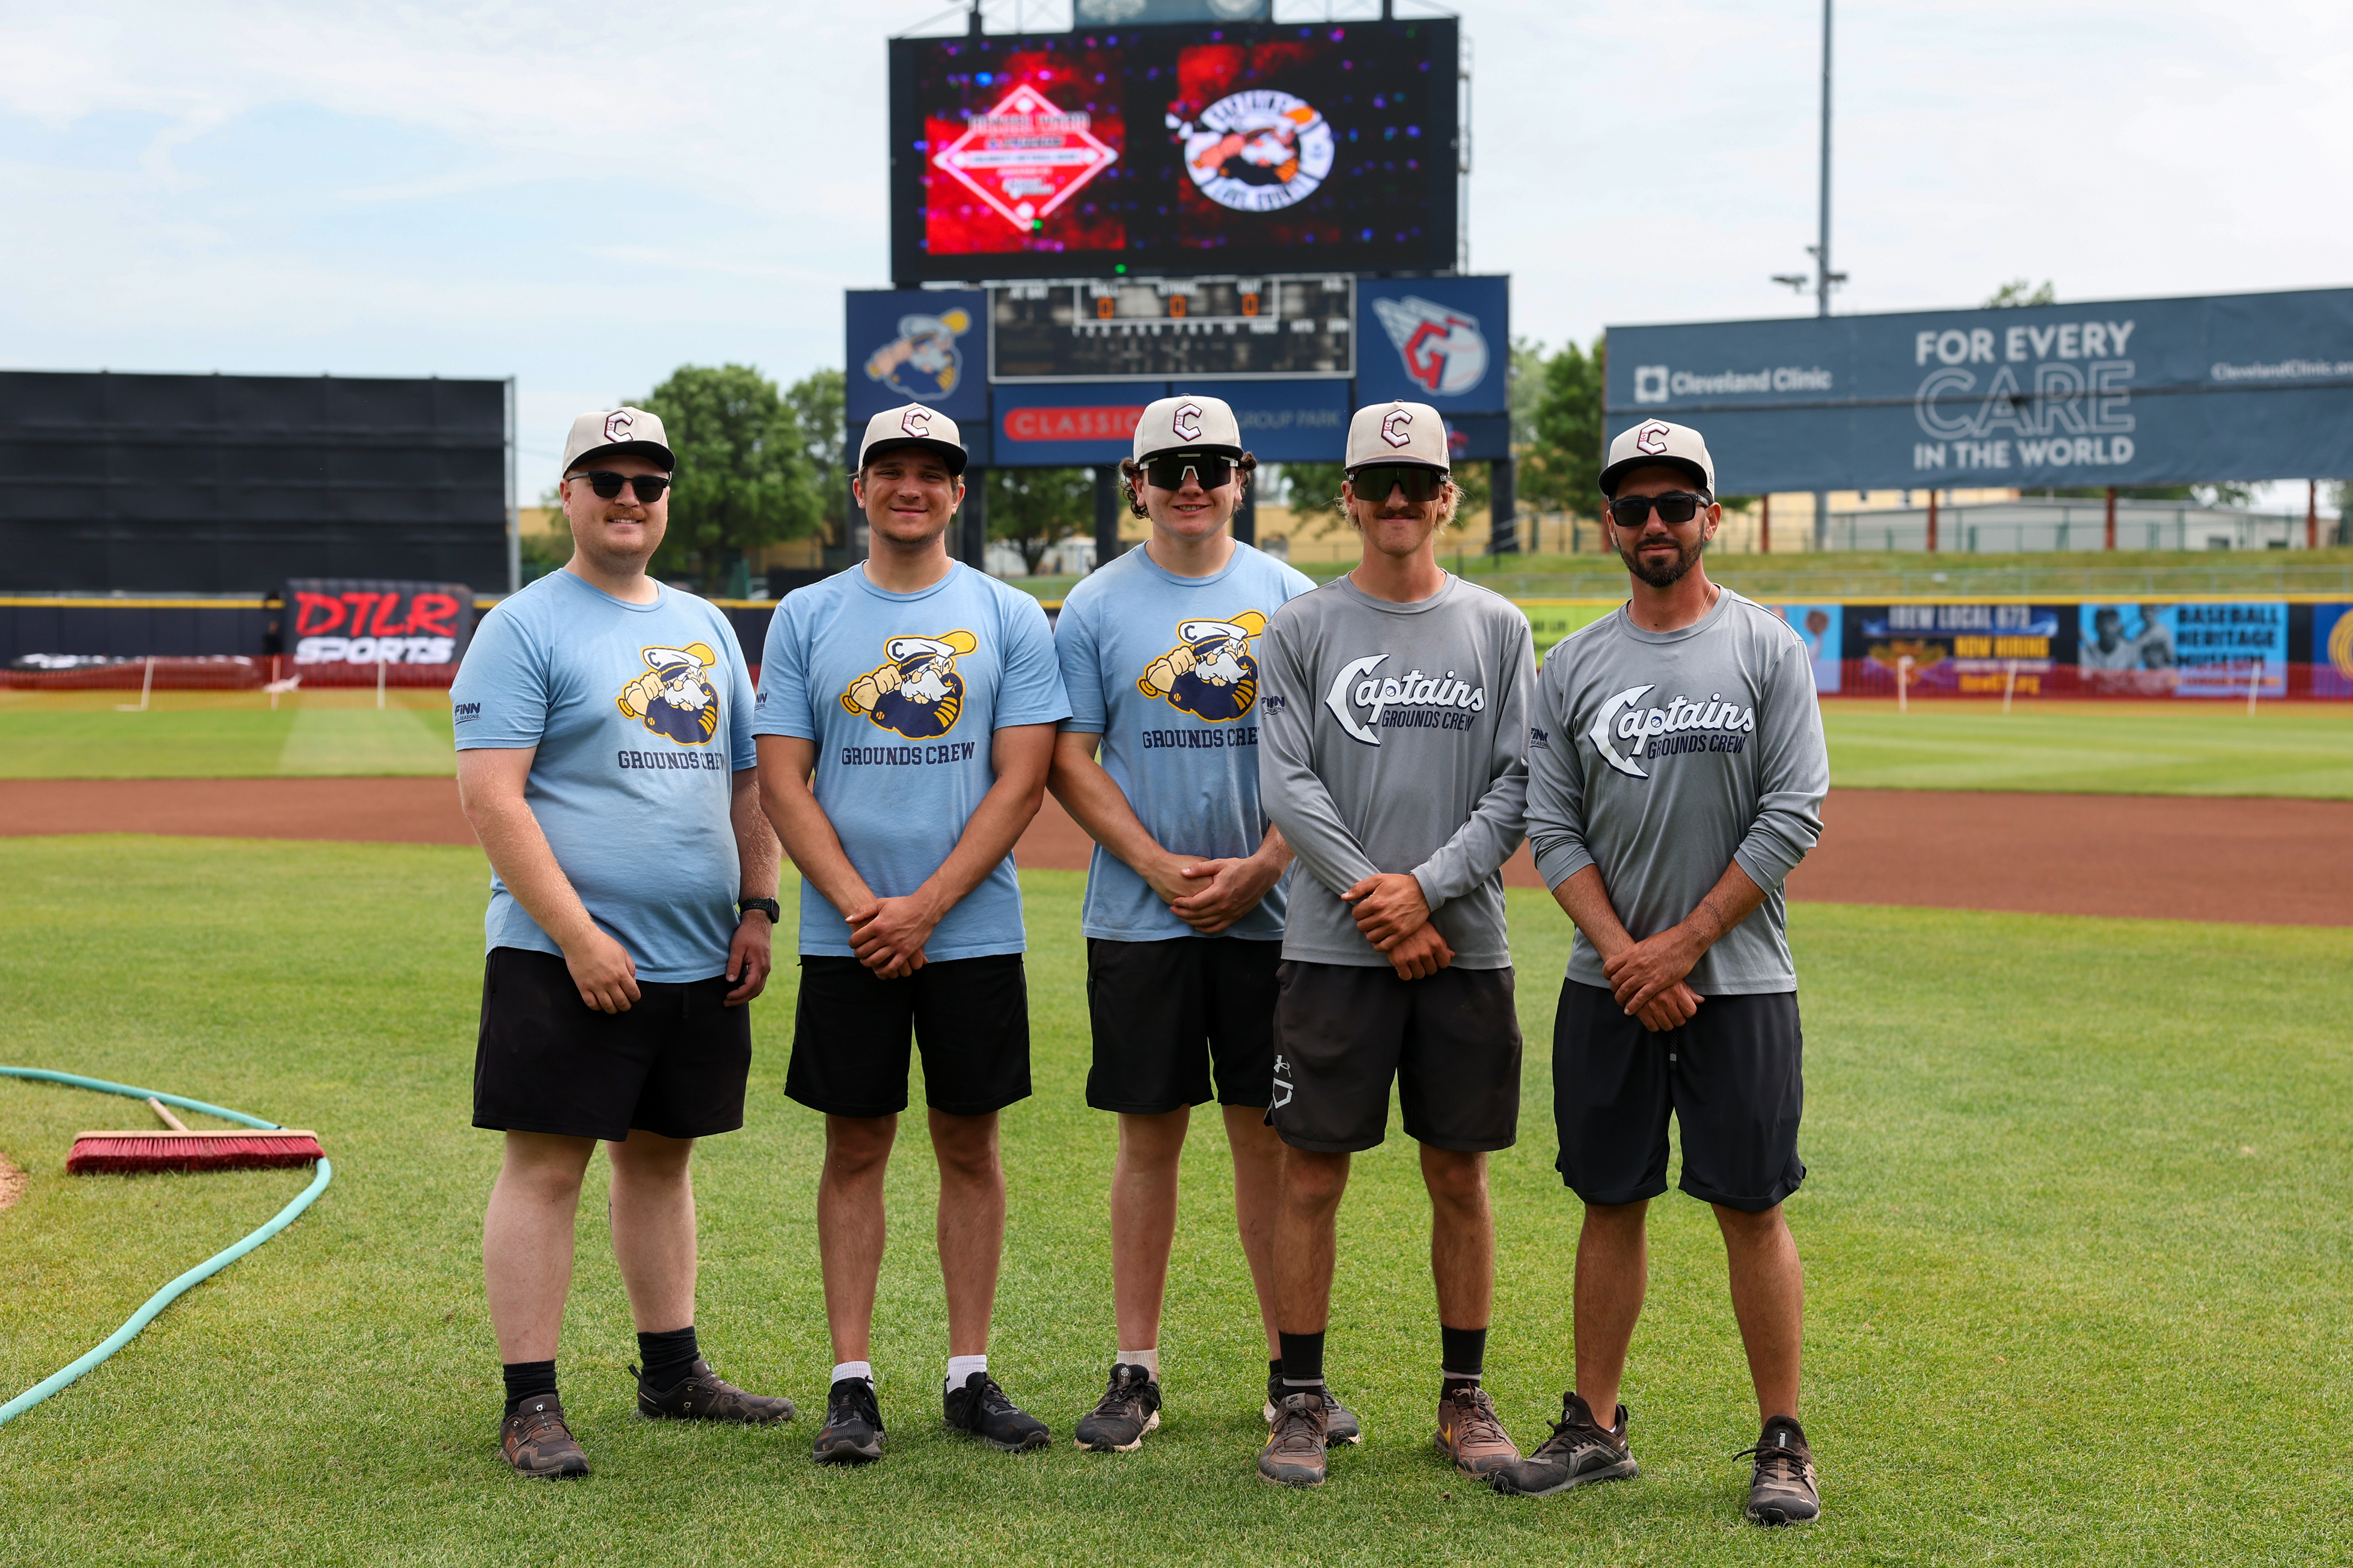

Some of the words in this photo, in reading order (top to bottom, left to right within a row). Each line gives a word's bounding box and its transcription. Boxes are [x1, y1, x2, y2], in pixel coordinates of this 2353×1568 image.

[1916, 328, 1995, 364] FOR
[2006, 320, 2135, 360] EVERY
[1671, 368, 1770, 395] Cleveland
[1773, 367, 1832, 392] Clinic
[1915, 361, 2135, 440] CARE
[1915, 442, 1945, 469] IN
[1953, 440, 2011, 469] THE
[2018, 437, 2135, 467] WORLD
[295, 592, 460, 637] DTLR
[2178, 608, 2278, 623] BASEBALL
[294, 636, 456, 664] SPORTS
[2178, 630, 2275, 646] HERITAGE
[1324, 653, 1486, 746] Captains
[1381, 710, 1440, 728] GROUNDS
[1442, 712, 1475, 732] CREW
[1588, 684, 1754, 779] Captains
[1143, 729, 1224, 748] GROUNDS
[1227, 727, 1259, 746] CRE
[1647, 735, 1707, 759] GROUNDS
[1709, 734, 1746, 754] CREW
[618, 751, 700, 769] GROUNDS
[842, 747, 922, 765] GROUNDS
[926, 742, 975, 764] CREW
